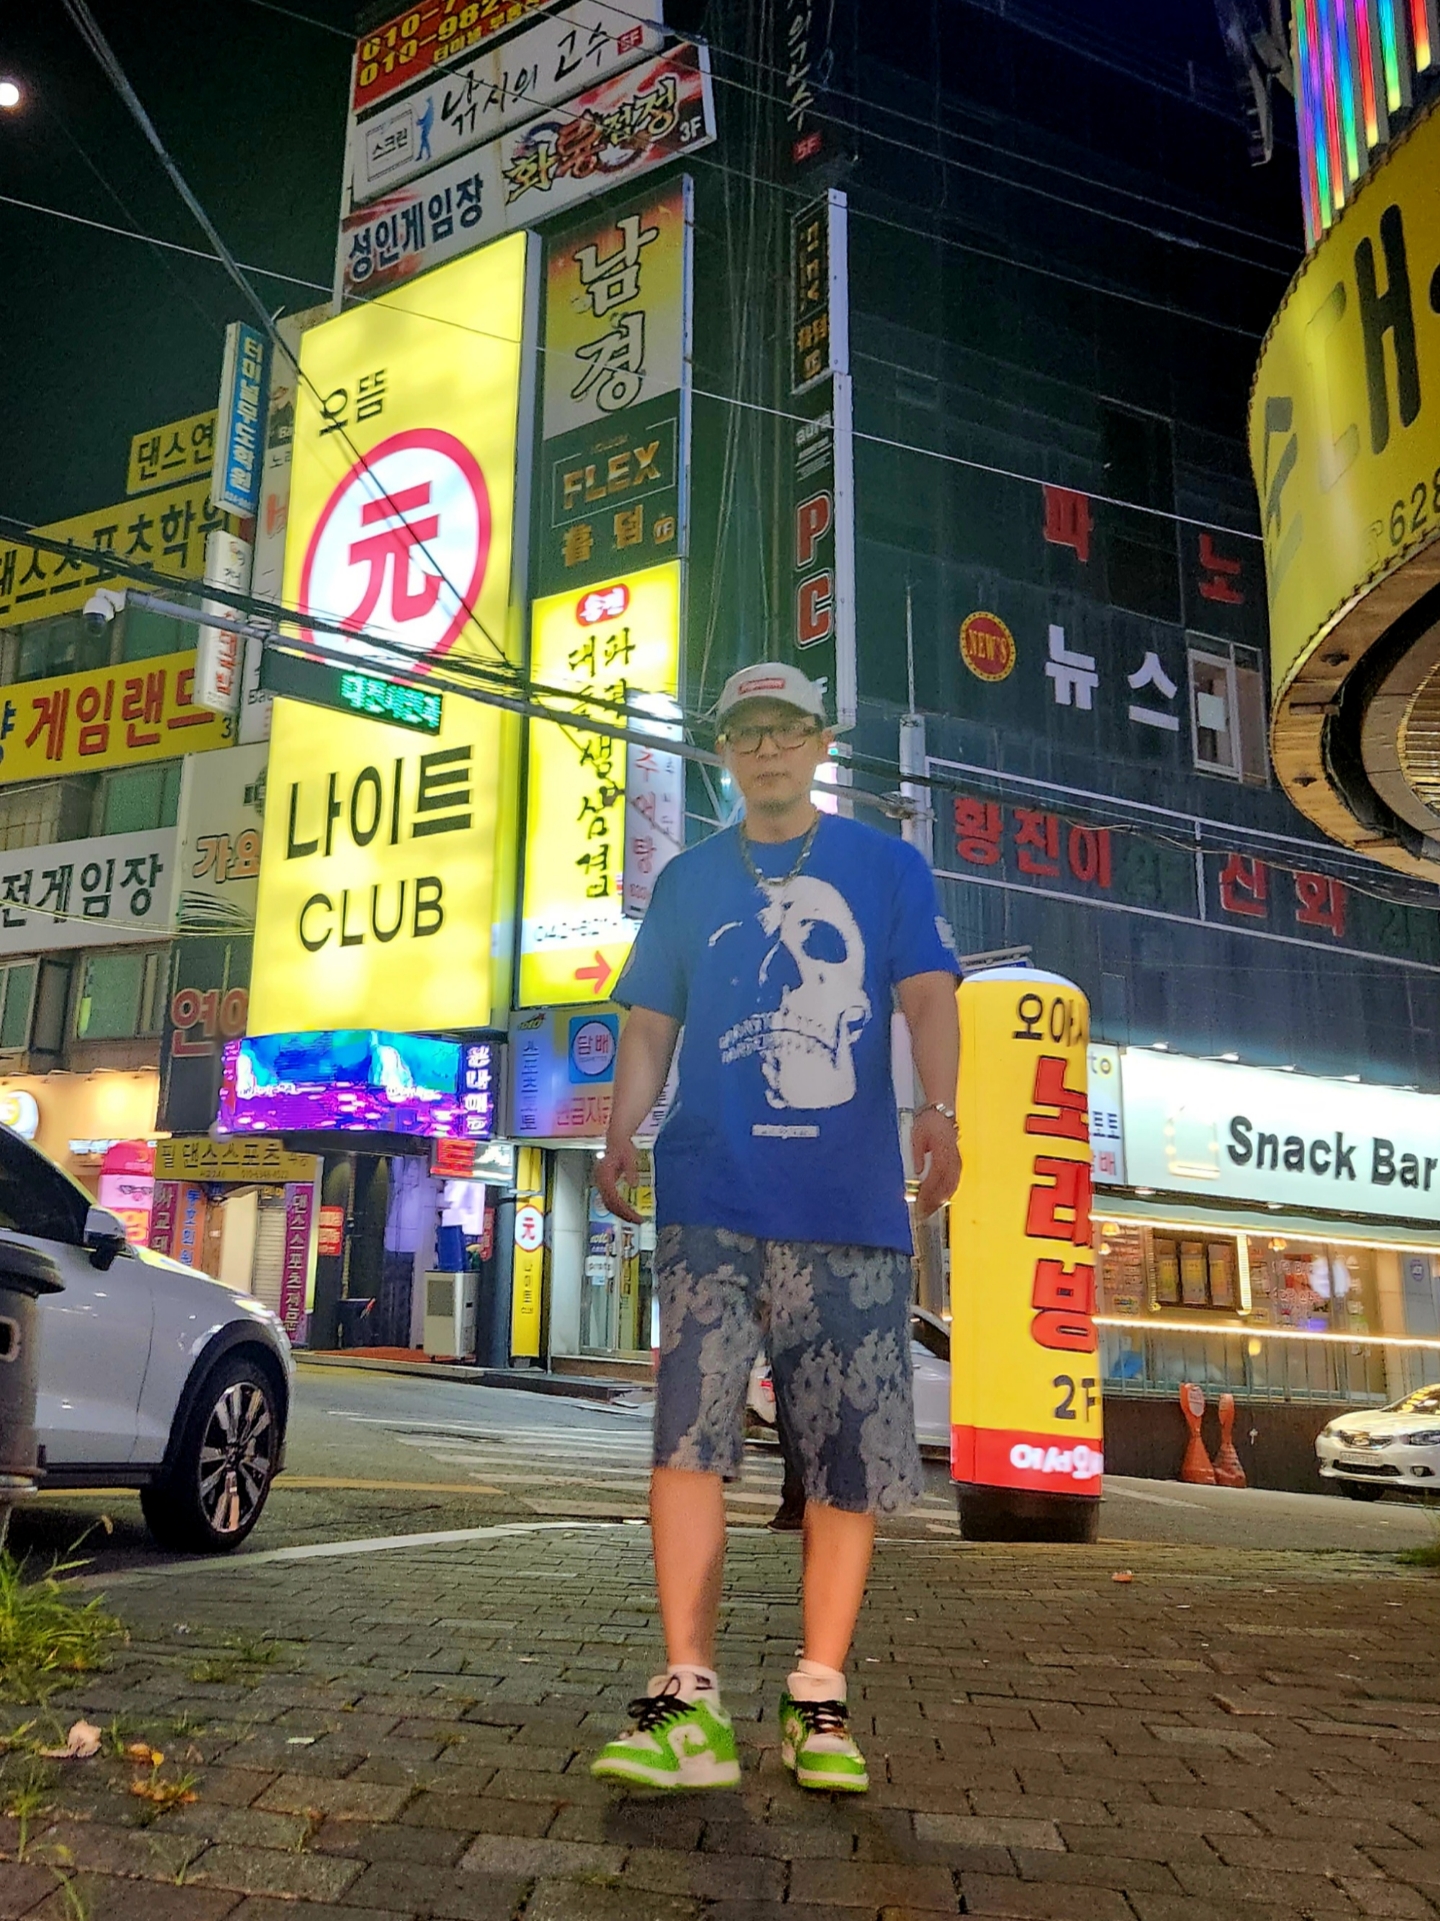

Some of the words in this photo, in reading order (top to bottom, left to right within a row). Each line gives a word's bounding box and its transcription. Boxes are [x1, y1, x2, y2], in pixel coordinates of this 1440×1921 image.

[440, 63, 539, 137] 낚시의
[554, 22, 611, 82] 고수
[371, 127, 409, 162] 스크린
[679, 116, 702, 142] 3F
[349, 172, 484, 282] 성인게임장
[570, 213, 661, 414] 남경
[137, 419, 215, 482] 댄스연
[564, 440, 661, 510] FLEX
[340, 479, 446, 643] 元
[25, 670, 217, 762] 게임랜드
[1044, 623, 1180, 732] 뉴스
[285, 744, 475, 861] 나이트
[192, 831, 260, 884] 가요
[954, 796, 1112, 889] 황진이
[1, 852, 164, 930] 전게임장
[298, 875, 445, 952] CLUB
[1219, 852, 1348, 938] 신화
[577, 1034, 611, 1056] 담배
[1226, 1115, 1357, 1182] Snack
[1370, 1136, 1439, 1194] Bar
[1052, 1374, 1100, 1424] 2F
